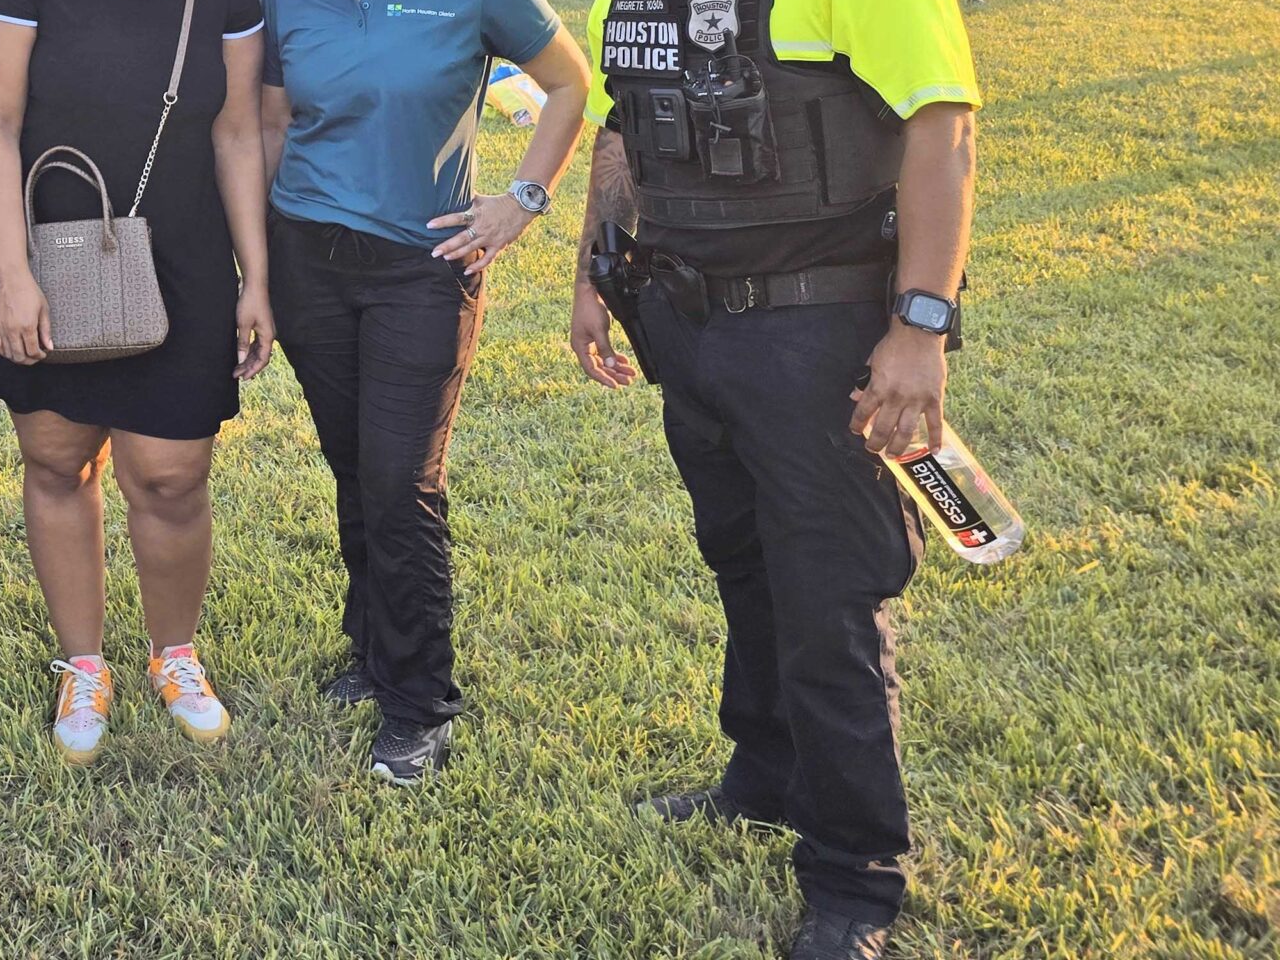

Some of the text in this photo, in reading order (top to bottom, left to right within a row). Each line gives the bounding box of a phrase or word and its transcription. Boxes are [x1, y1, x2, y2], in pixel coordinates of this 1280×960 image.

[615, 0, 644, 11] NEGRETE
[697, 1, 729, 13] HOUSTON
[605, 21, 679, 45] HOUSTON
[697, 34, 723, 42] POLIC
[603, 46, 680, 71] POLICE
[55, 236, 84, 245] GUESS
[912, 462, 966, 525] essentia
